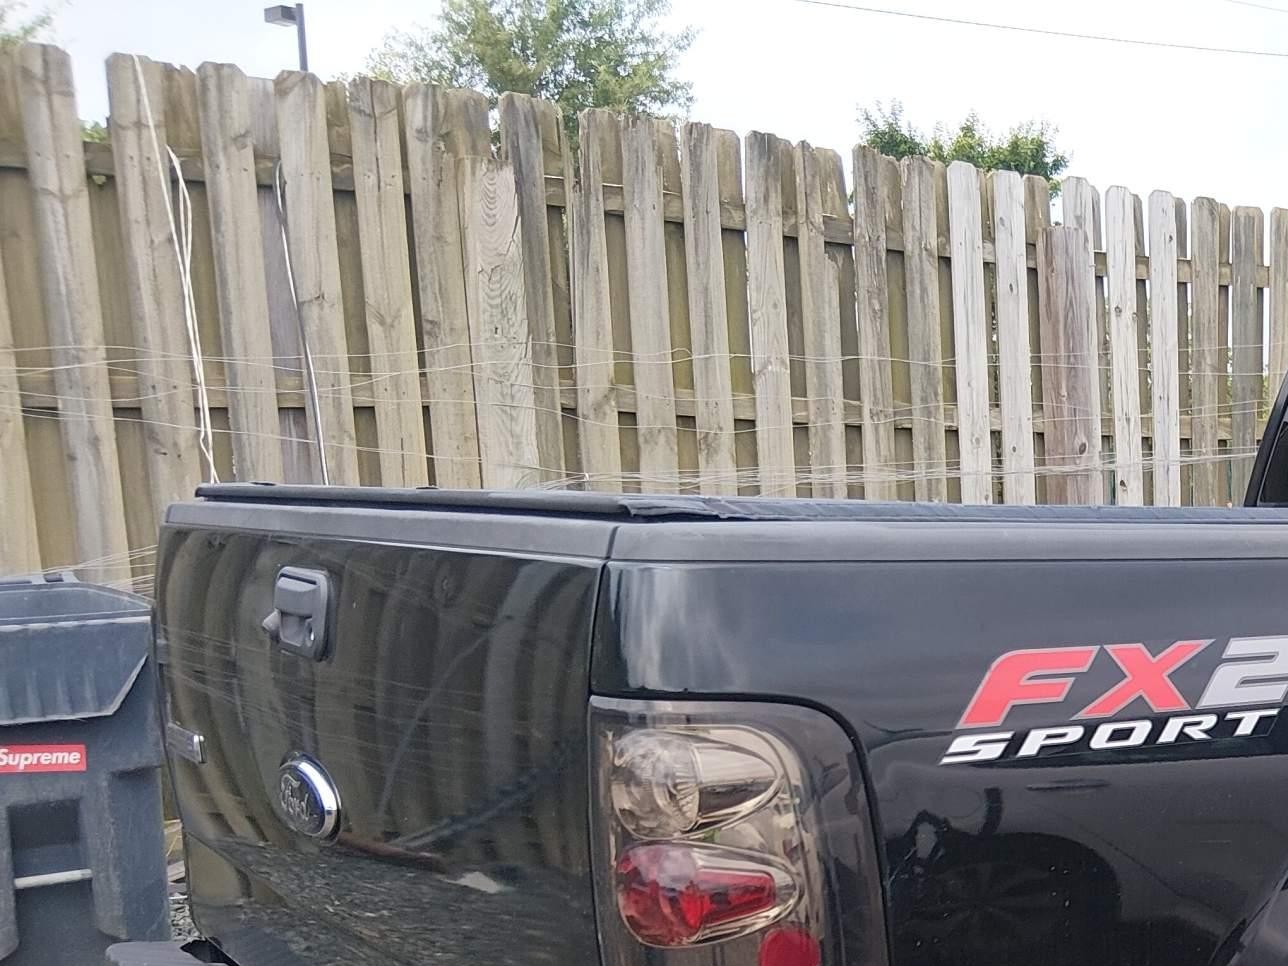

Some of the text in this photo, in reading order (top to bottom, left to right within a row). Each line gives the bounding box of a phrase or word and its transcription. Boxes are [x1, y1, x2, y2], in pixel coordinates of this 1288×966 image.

[0, 748, 81, 770] Supreme
[938, 707, 1281, 765] SPORT
[280, 773, 319, 821] Ford
